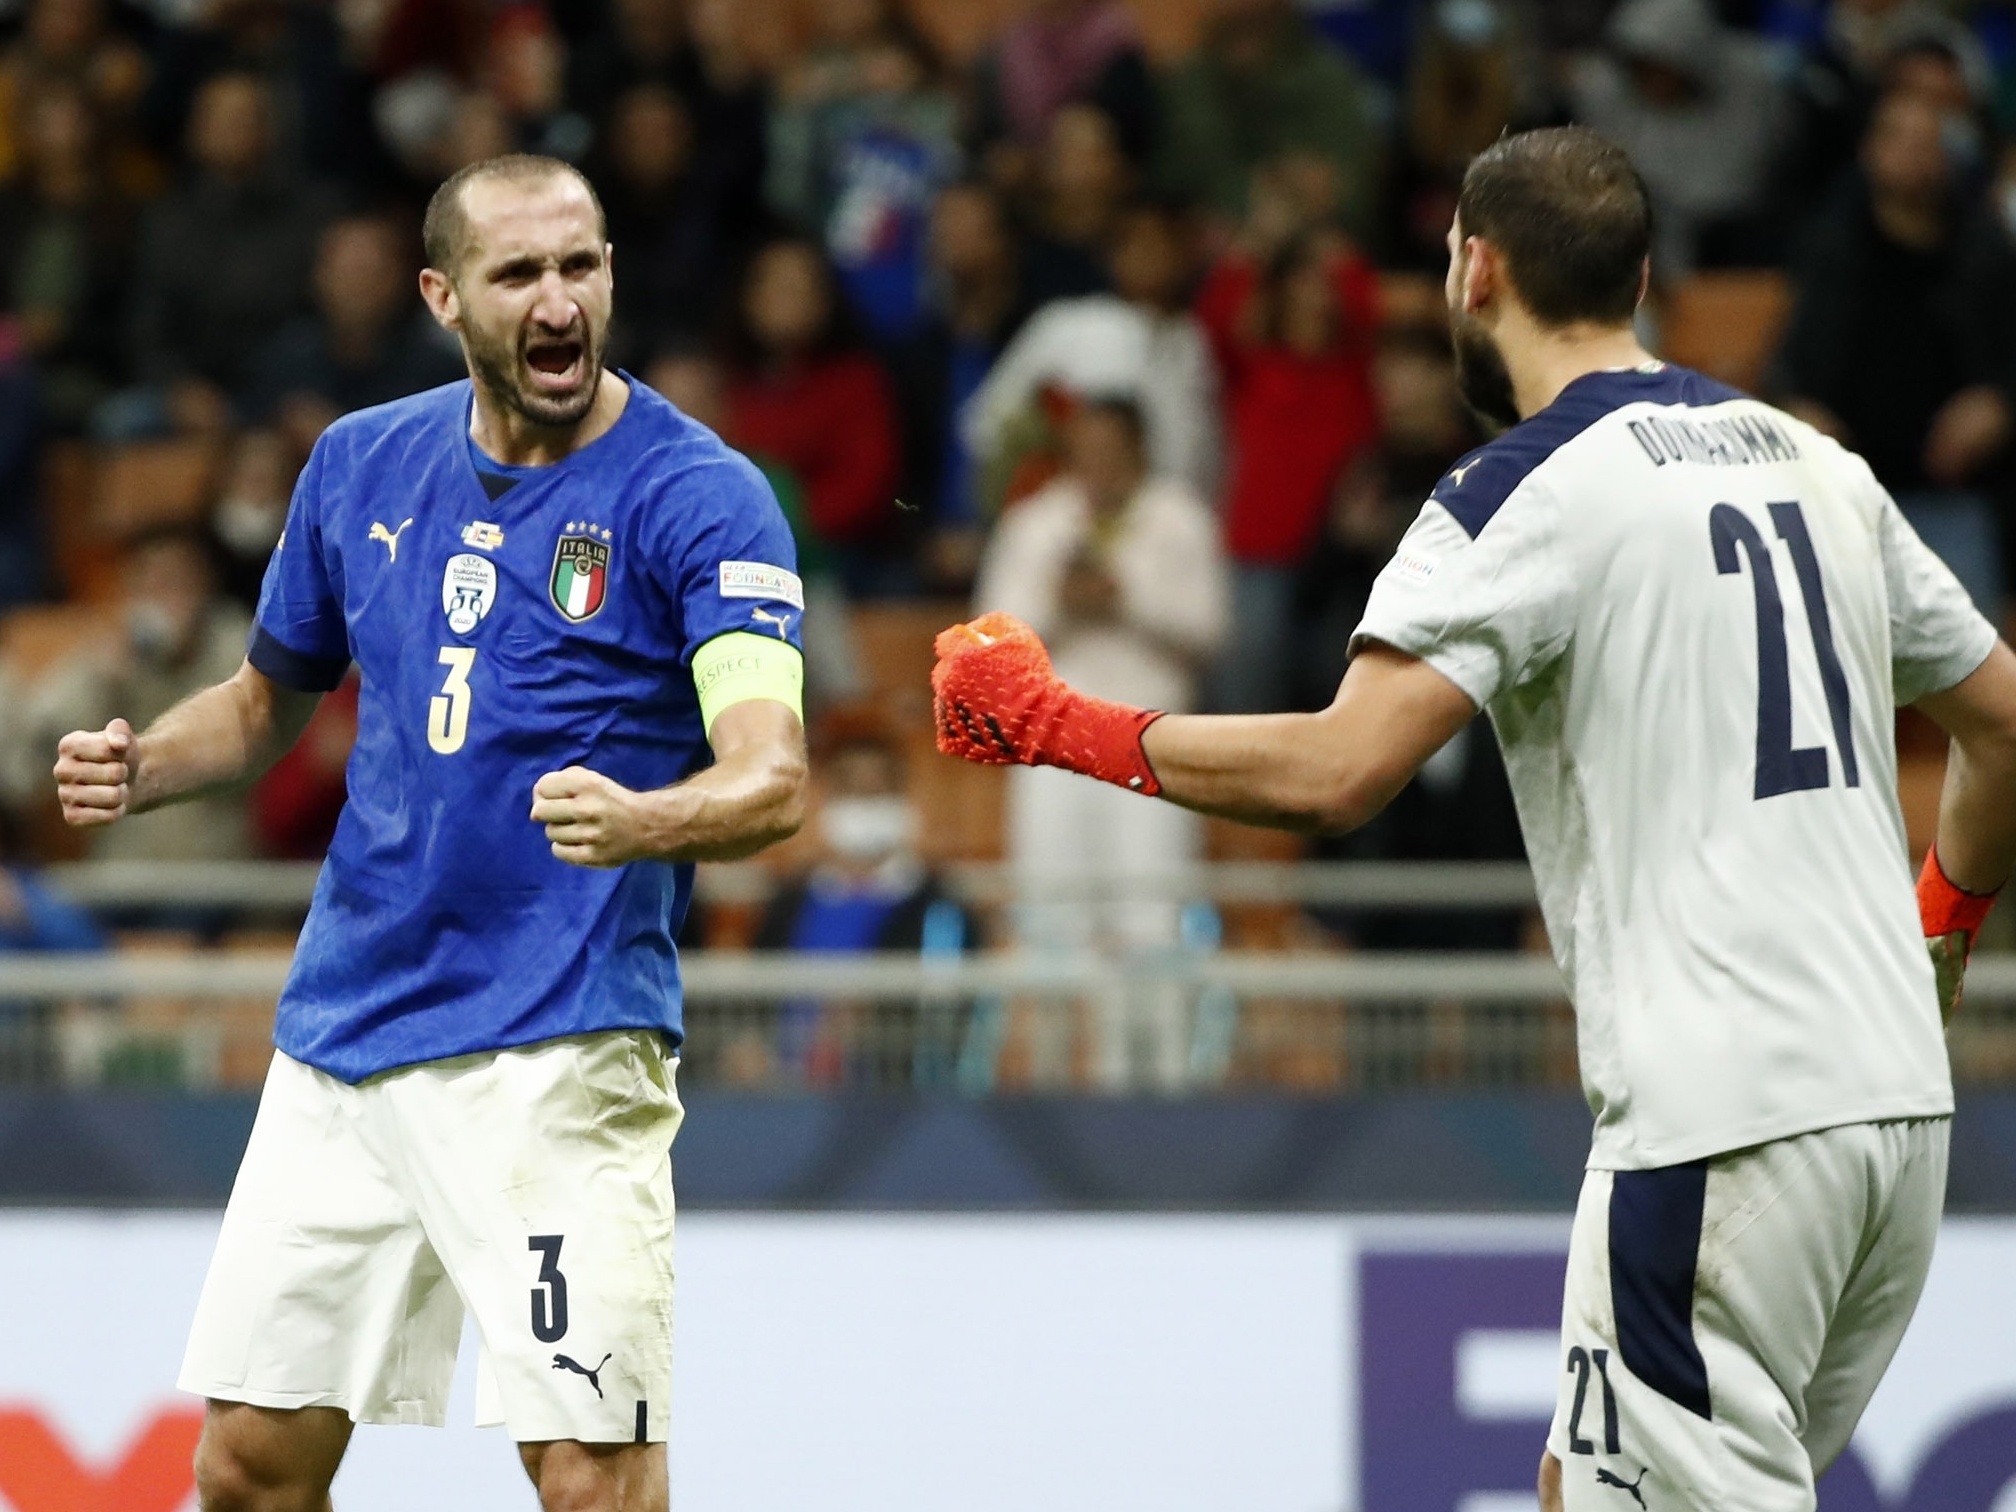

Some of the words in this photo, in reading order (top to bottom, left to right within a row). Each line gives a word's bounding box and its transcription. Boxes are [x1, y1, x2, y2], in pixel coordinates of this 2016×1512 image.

[1626, 414, 1799, 467] DONAUMMA
[563, 541, 606, 562] ITALIA
[723, 572, 799, 600] FOUNDAT
[427, 646, 477, 754] 3
[1709, 500, 1860, 801] 21
[527, 1234, 568, 1343] 3
[1567, 1345, 1621, 1456] 21
